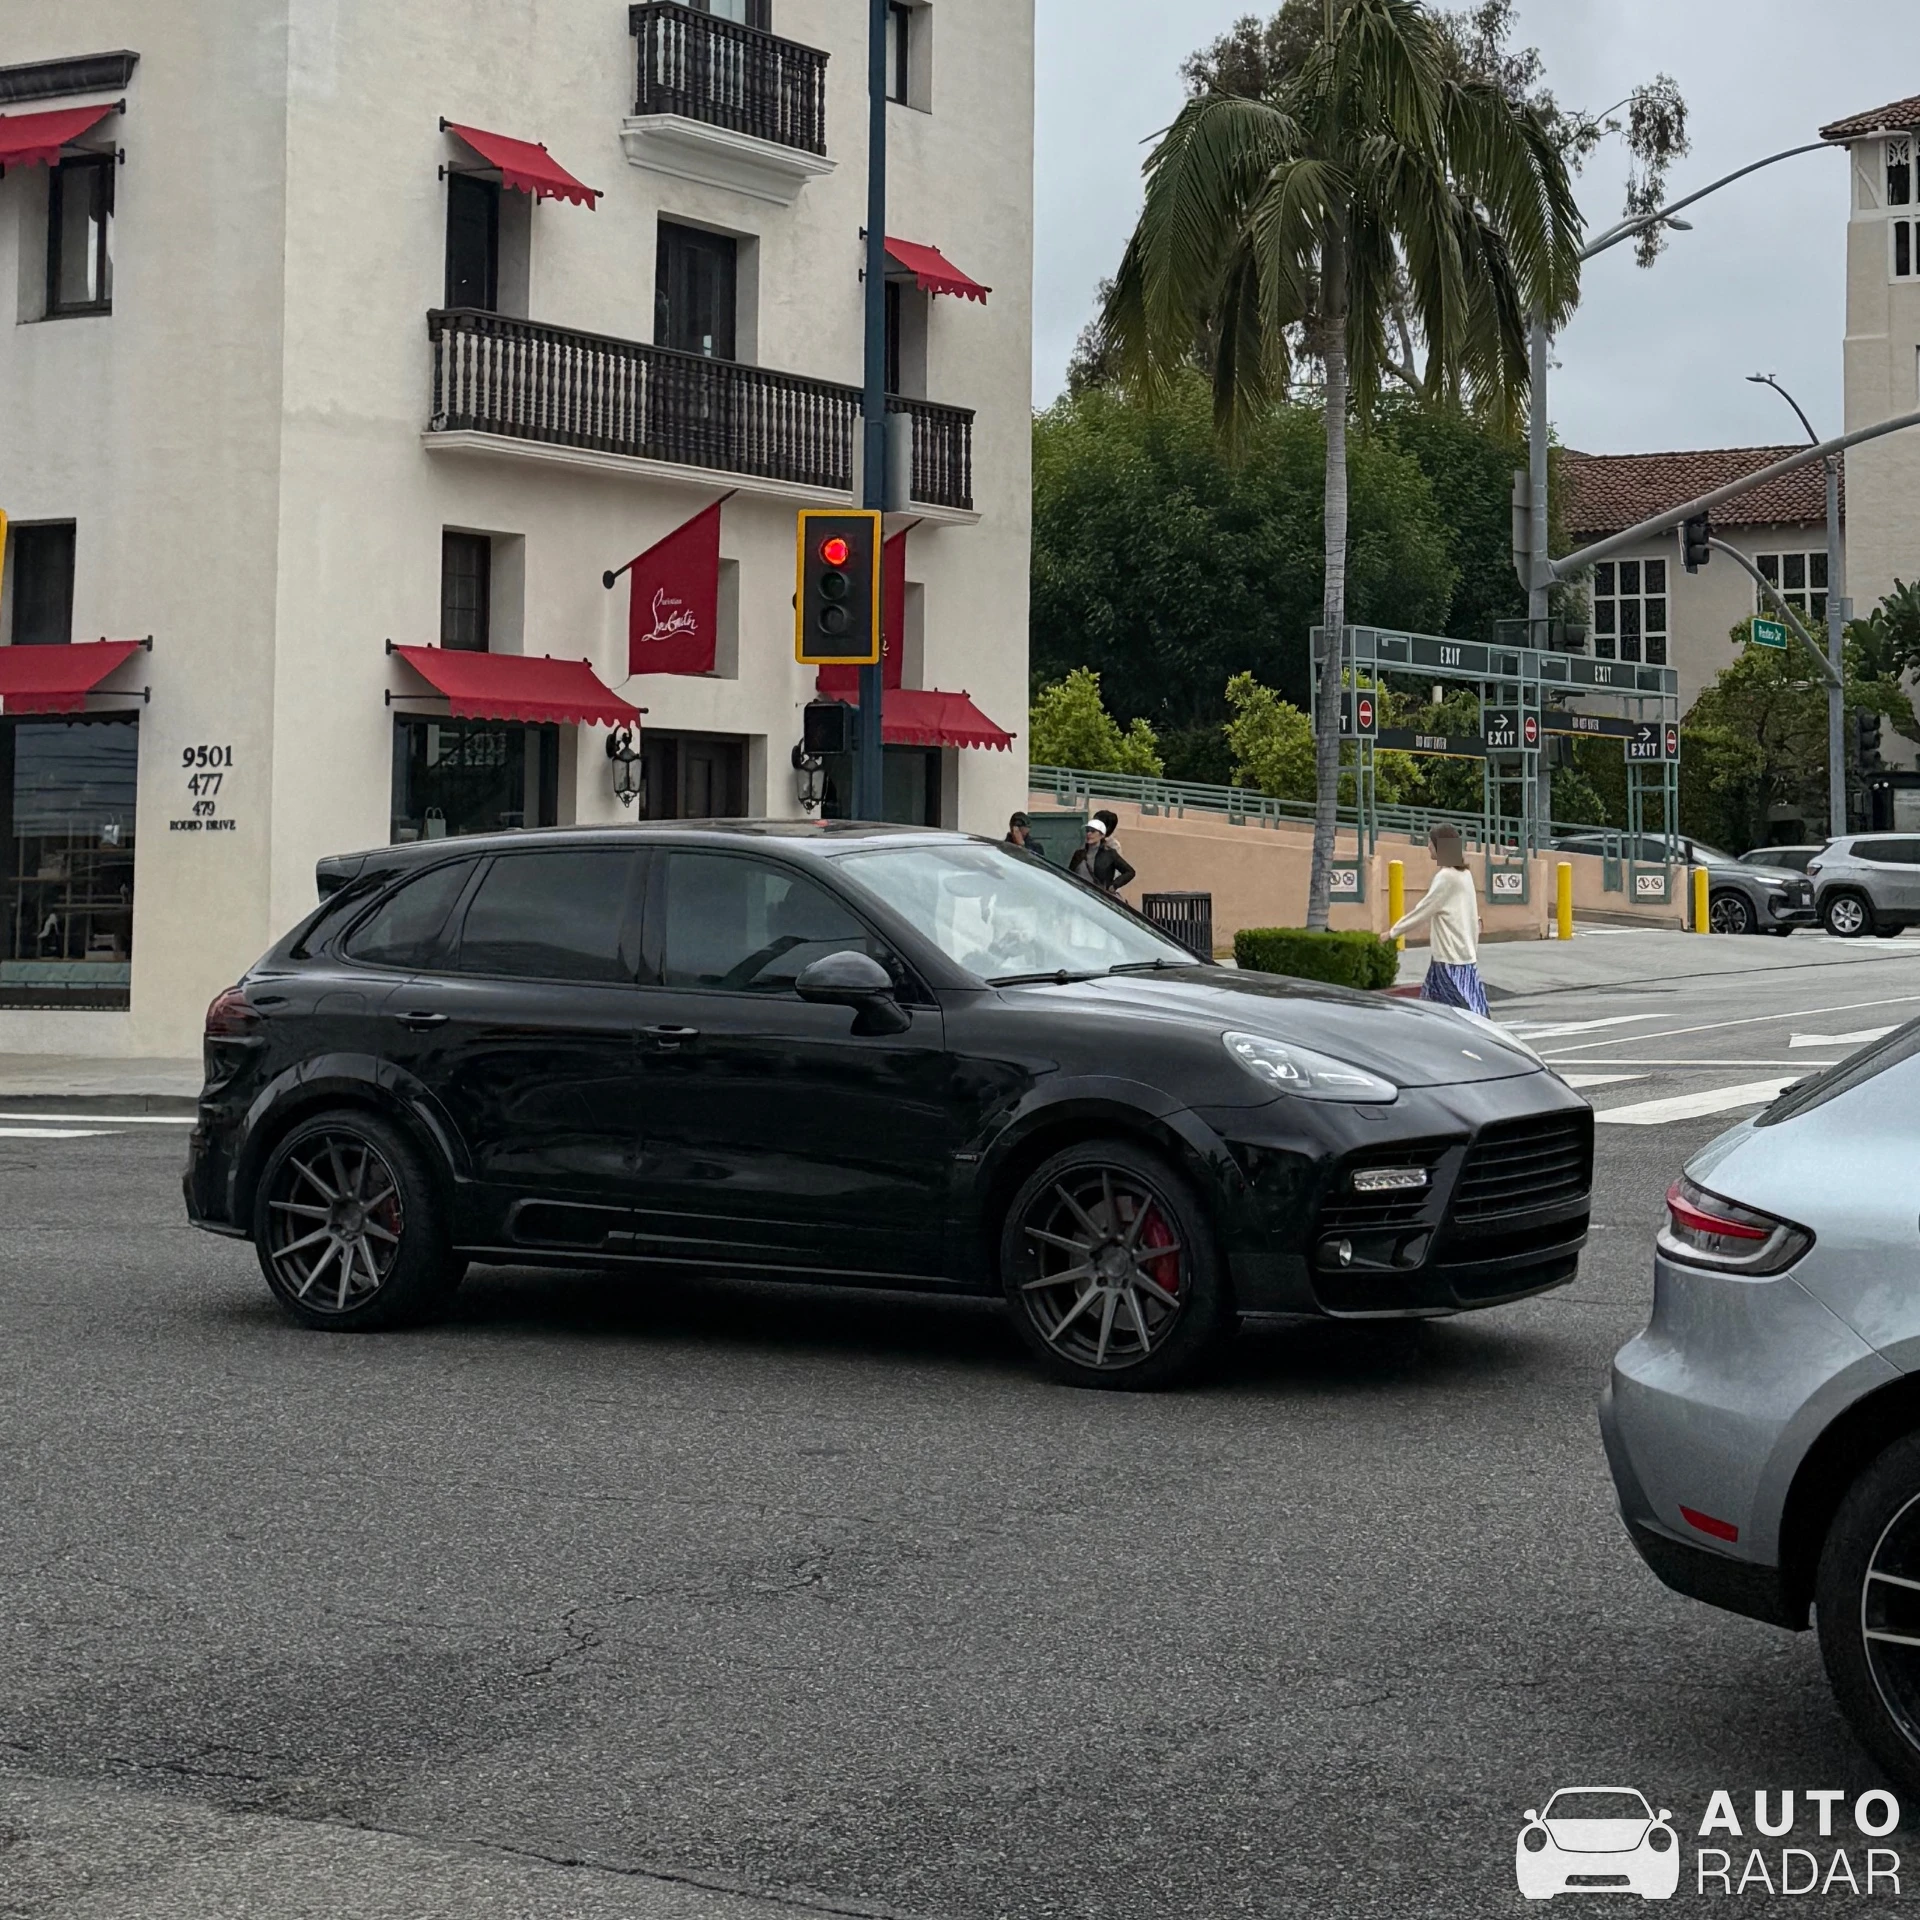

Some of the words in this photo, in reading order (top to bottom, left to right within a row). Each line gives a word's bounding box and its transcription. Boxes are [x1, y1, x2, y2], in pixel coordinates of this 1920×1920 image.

[1440, 646, 1461, 666] EXIT
[1594, 665, 1612, 683] EXIT
[1487, 731, 1516, 746] EXIT
[181, 745, 233, 768] 9501
[1631, 743, 1657, 757] EXIT
[187, 773, 223, 796] 477
[192, 800, 216, 816] 479
[206, 820, 236, 831] DRIVE
